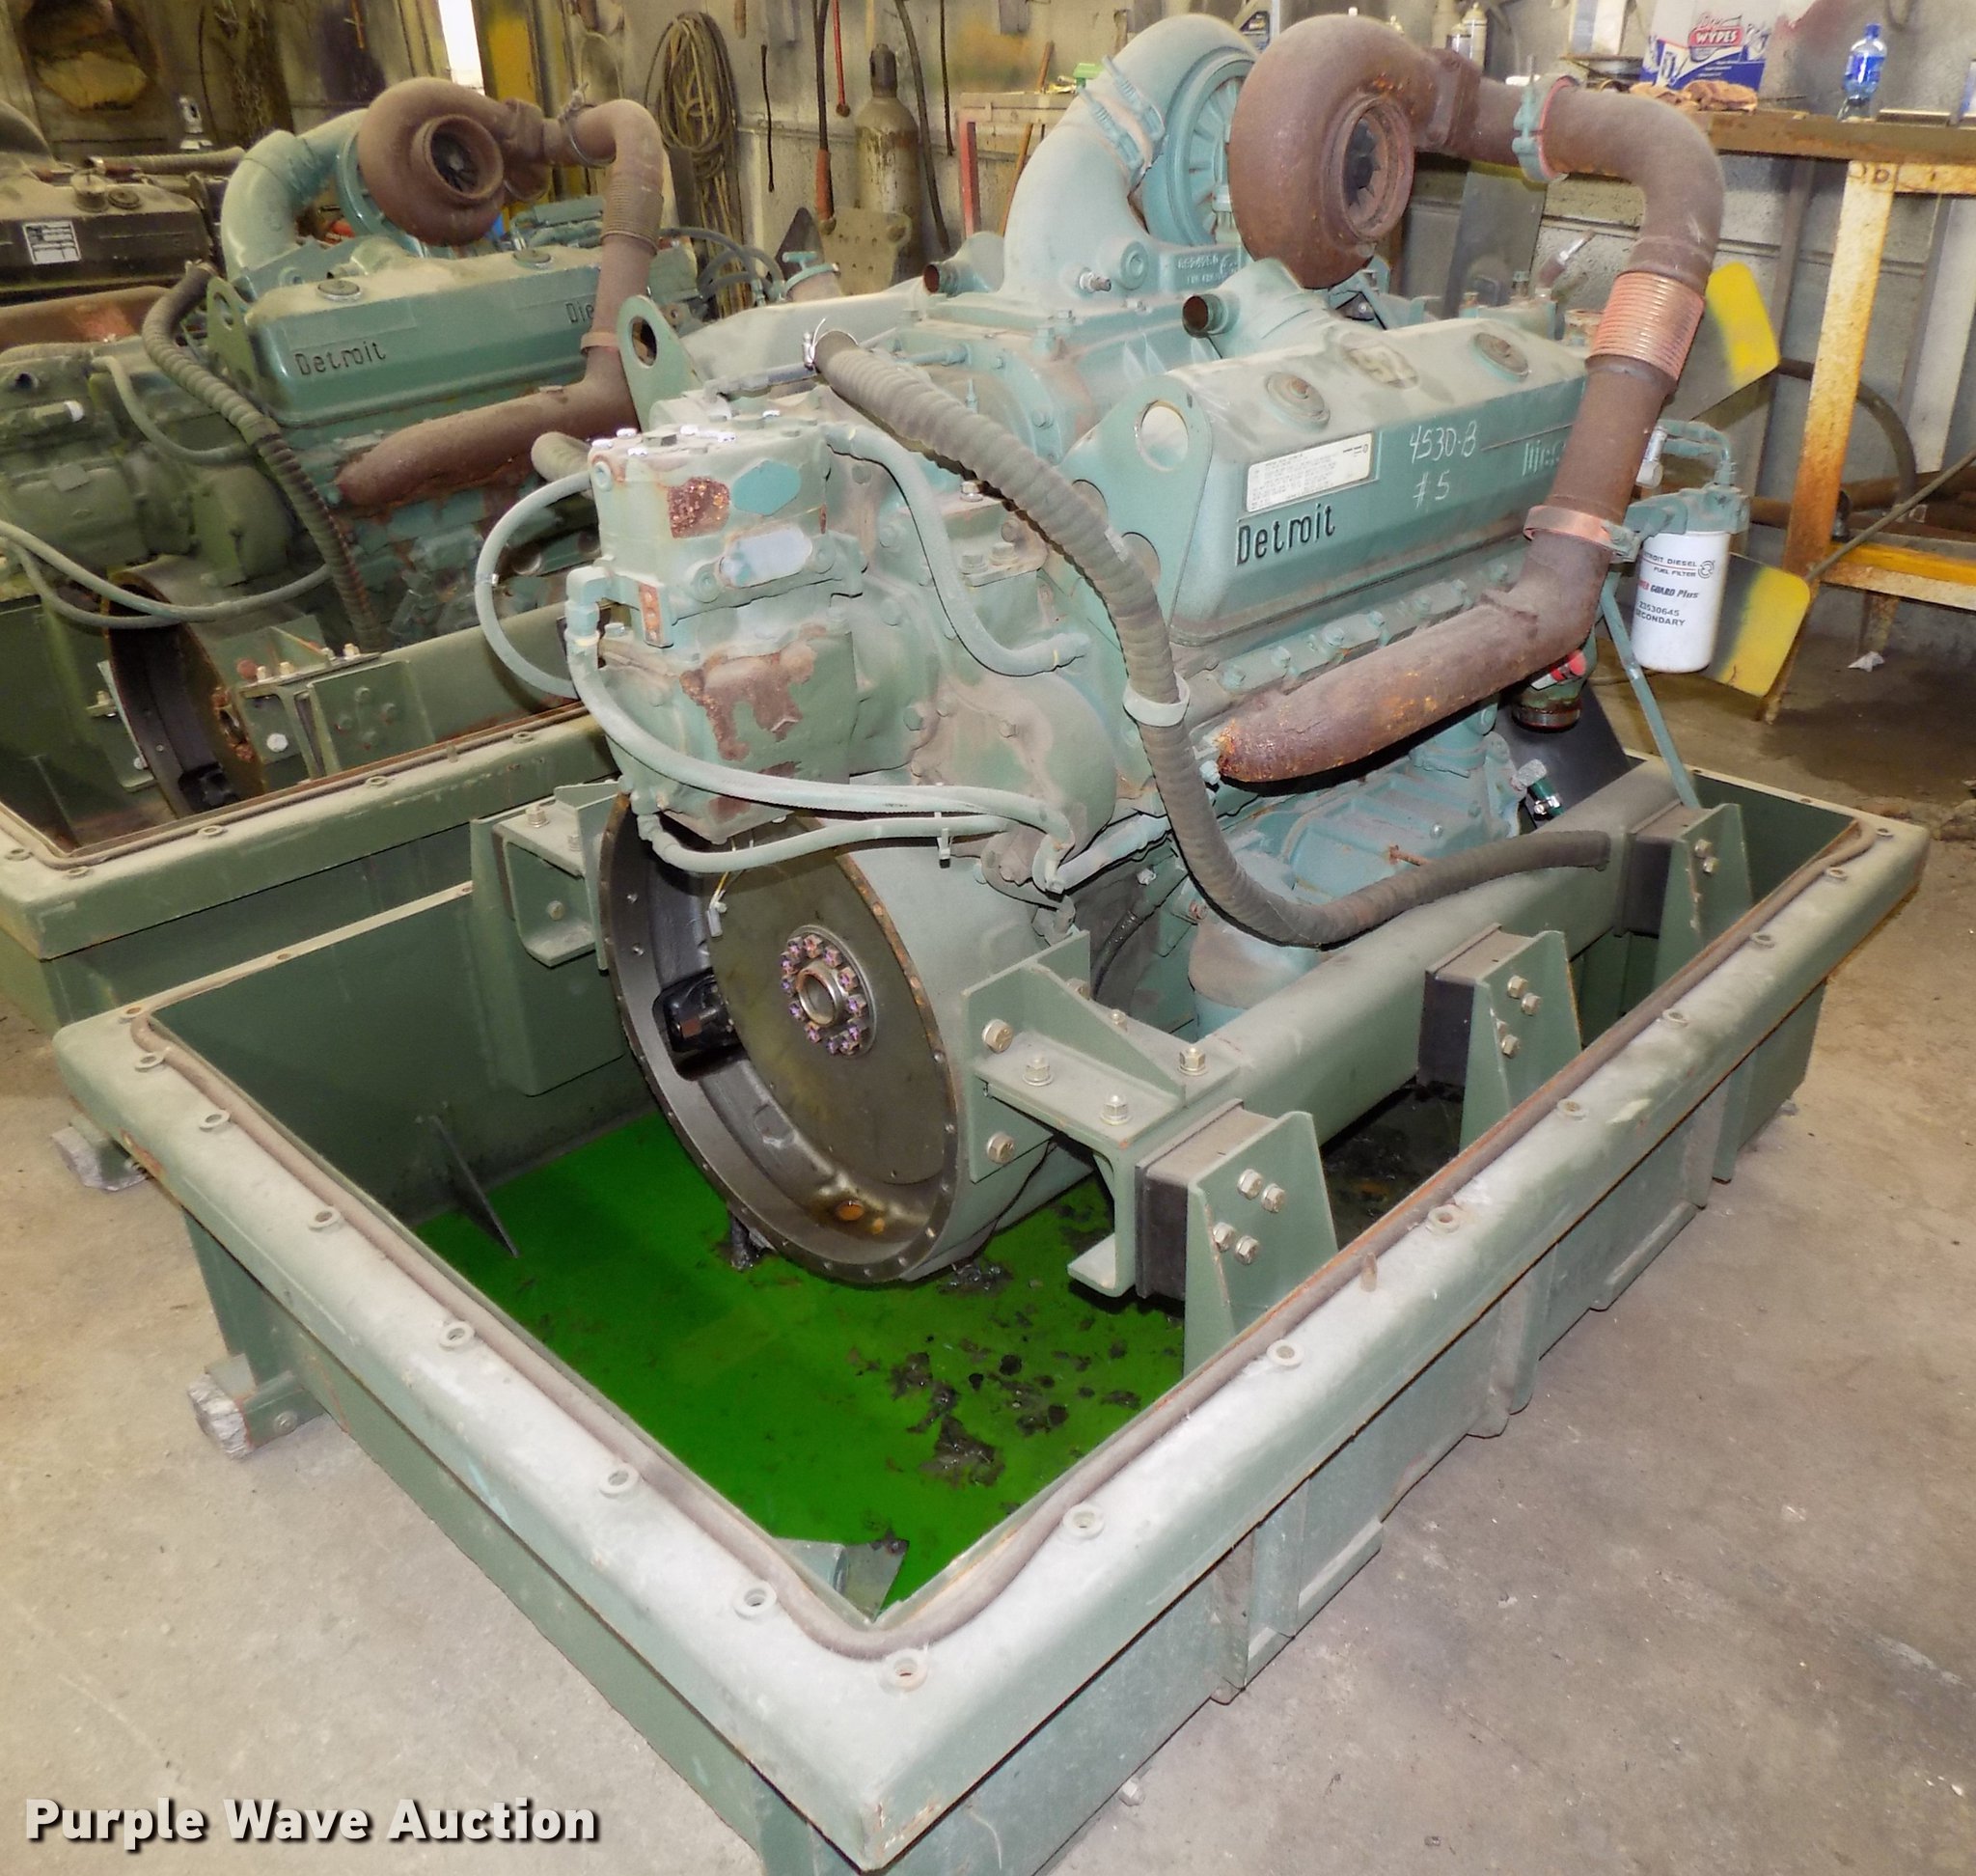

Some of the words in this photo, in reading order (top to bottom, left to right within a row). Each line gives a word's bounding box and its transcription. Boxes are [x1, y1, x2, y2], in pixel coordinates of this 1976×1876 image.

[295, 341, 386, 376] Detroit
[1236, 503, 1336, 567] Detroit
[1666, 558, 1697, 567] DIESEL
[1653, 566, 1670, 575] FUEL
[1671, 569, 1697, 578] FILTER
[1676, 589, 1700, 599] Plus
